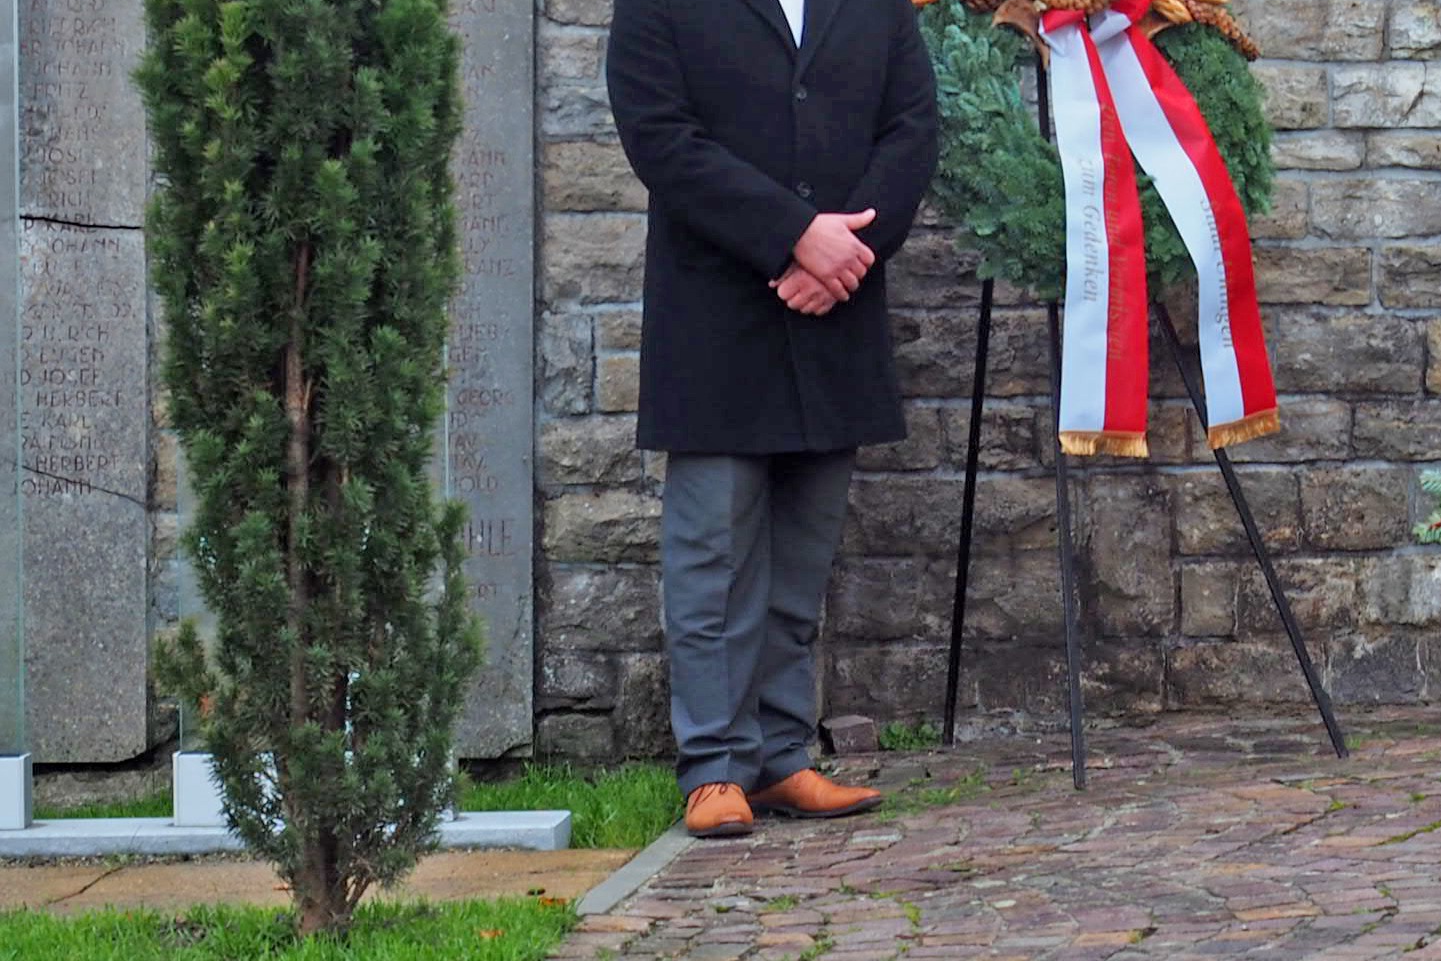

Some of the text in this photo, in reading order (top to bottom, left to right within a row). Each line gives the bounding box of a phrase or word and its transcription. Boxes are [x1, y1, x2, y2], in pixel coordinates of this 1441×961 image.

[1077, 156, 1104, 304] zum Gedenken
[35, 454, 120, 473] HERBERT
